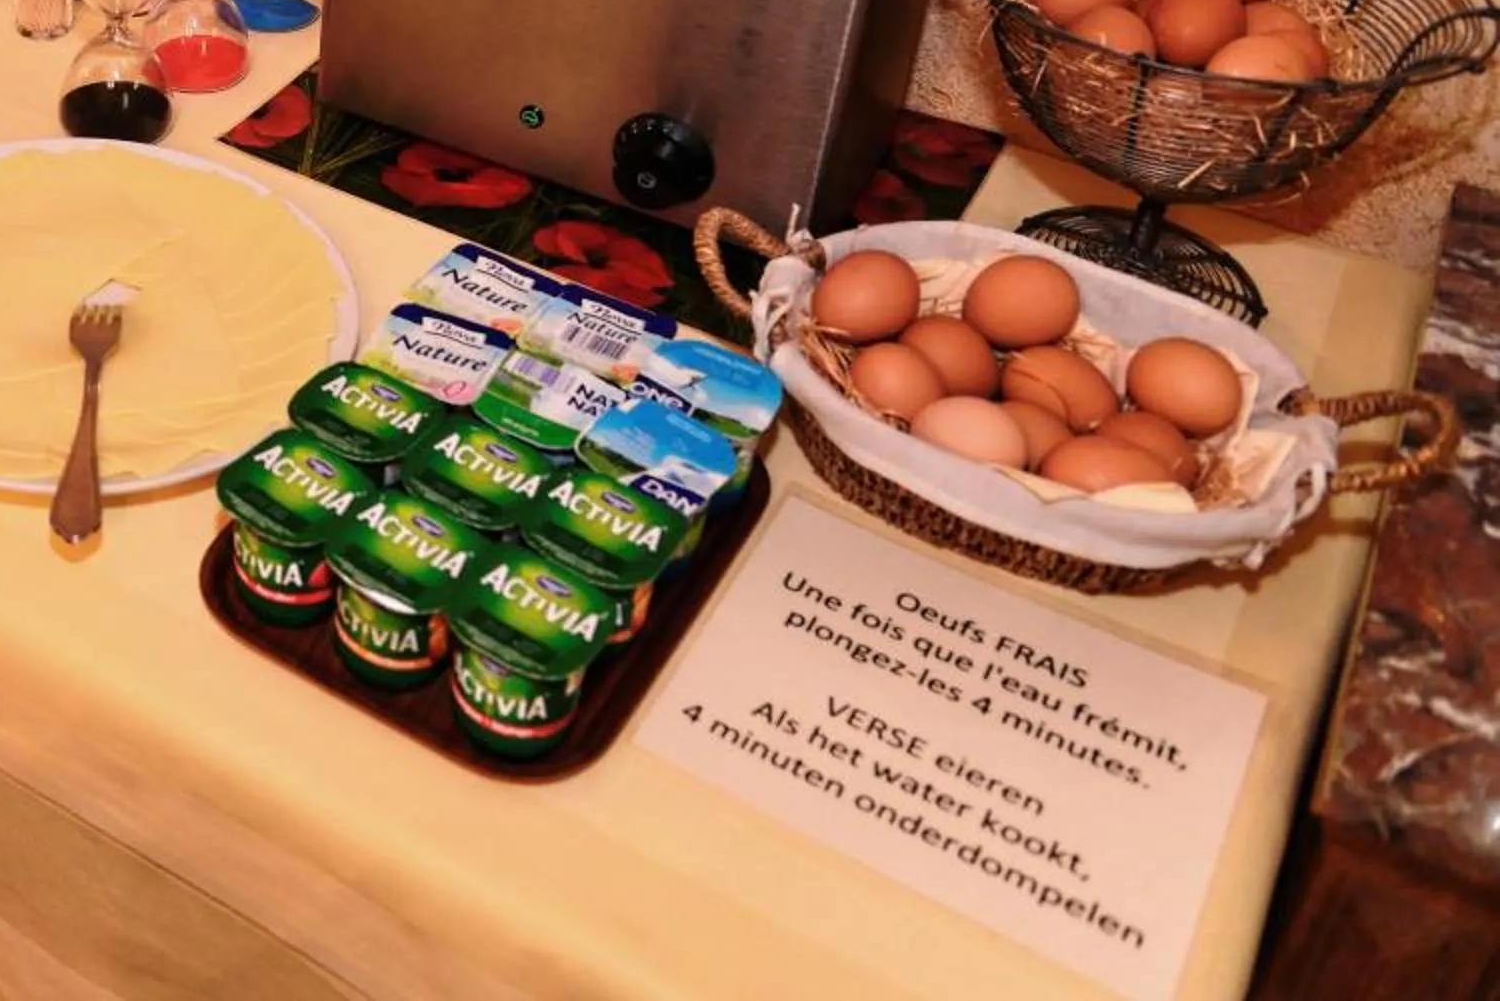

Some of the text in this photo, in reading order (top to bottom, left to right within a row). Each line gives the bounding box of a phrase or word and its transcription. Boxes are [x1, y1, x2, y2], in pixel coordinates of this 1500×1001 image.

[442, 268, 529, 312] Nature
[567, 312, 638, 344] Nature
[393, 334, 487, 372] Nature
[321, 375, 423, 434] ACTIVIA
[254, 444, 356, 516] ACTIVIA
[434, 432, 543, 498] ACTIVIA
[357, 502, 468, 578] ACTIVIA
[548, 480, 662, 552] ACTIVIA
[480, 564, 599, 642] ACTIVIA
[782, 570, 843, 612] Une
[850, 603, 906, 641] fois
[913, 636, 974, 674] que
[983, 662, 1062, 712] l'eau
[895, 592, 1089, 688] Oeufs FRAIS
[783, 611, 1151, 790] plongez-les 4 minutes.
[751, 702, 1090, 882] Als het water kookt,
[827, 696, 1045, 816] VERSE eieren
[681, 704, 1146, 949] 4 minuten onderdompelen
